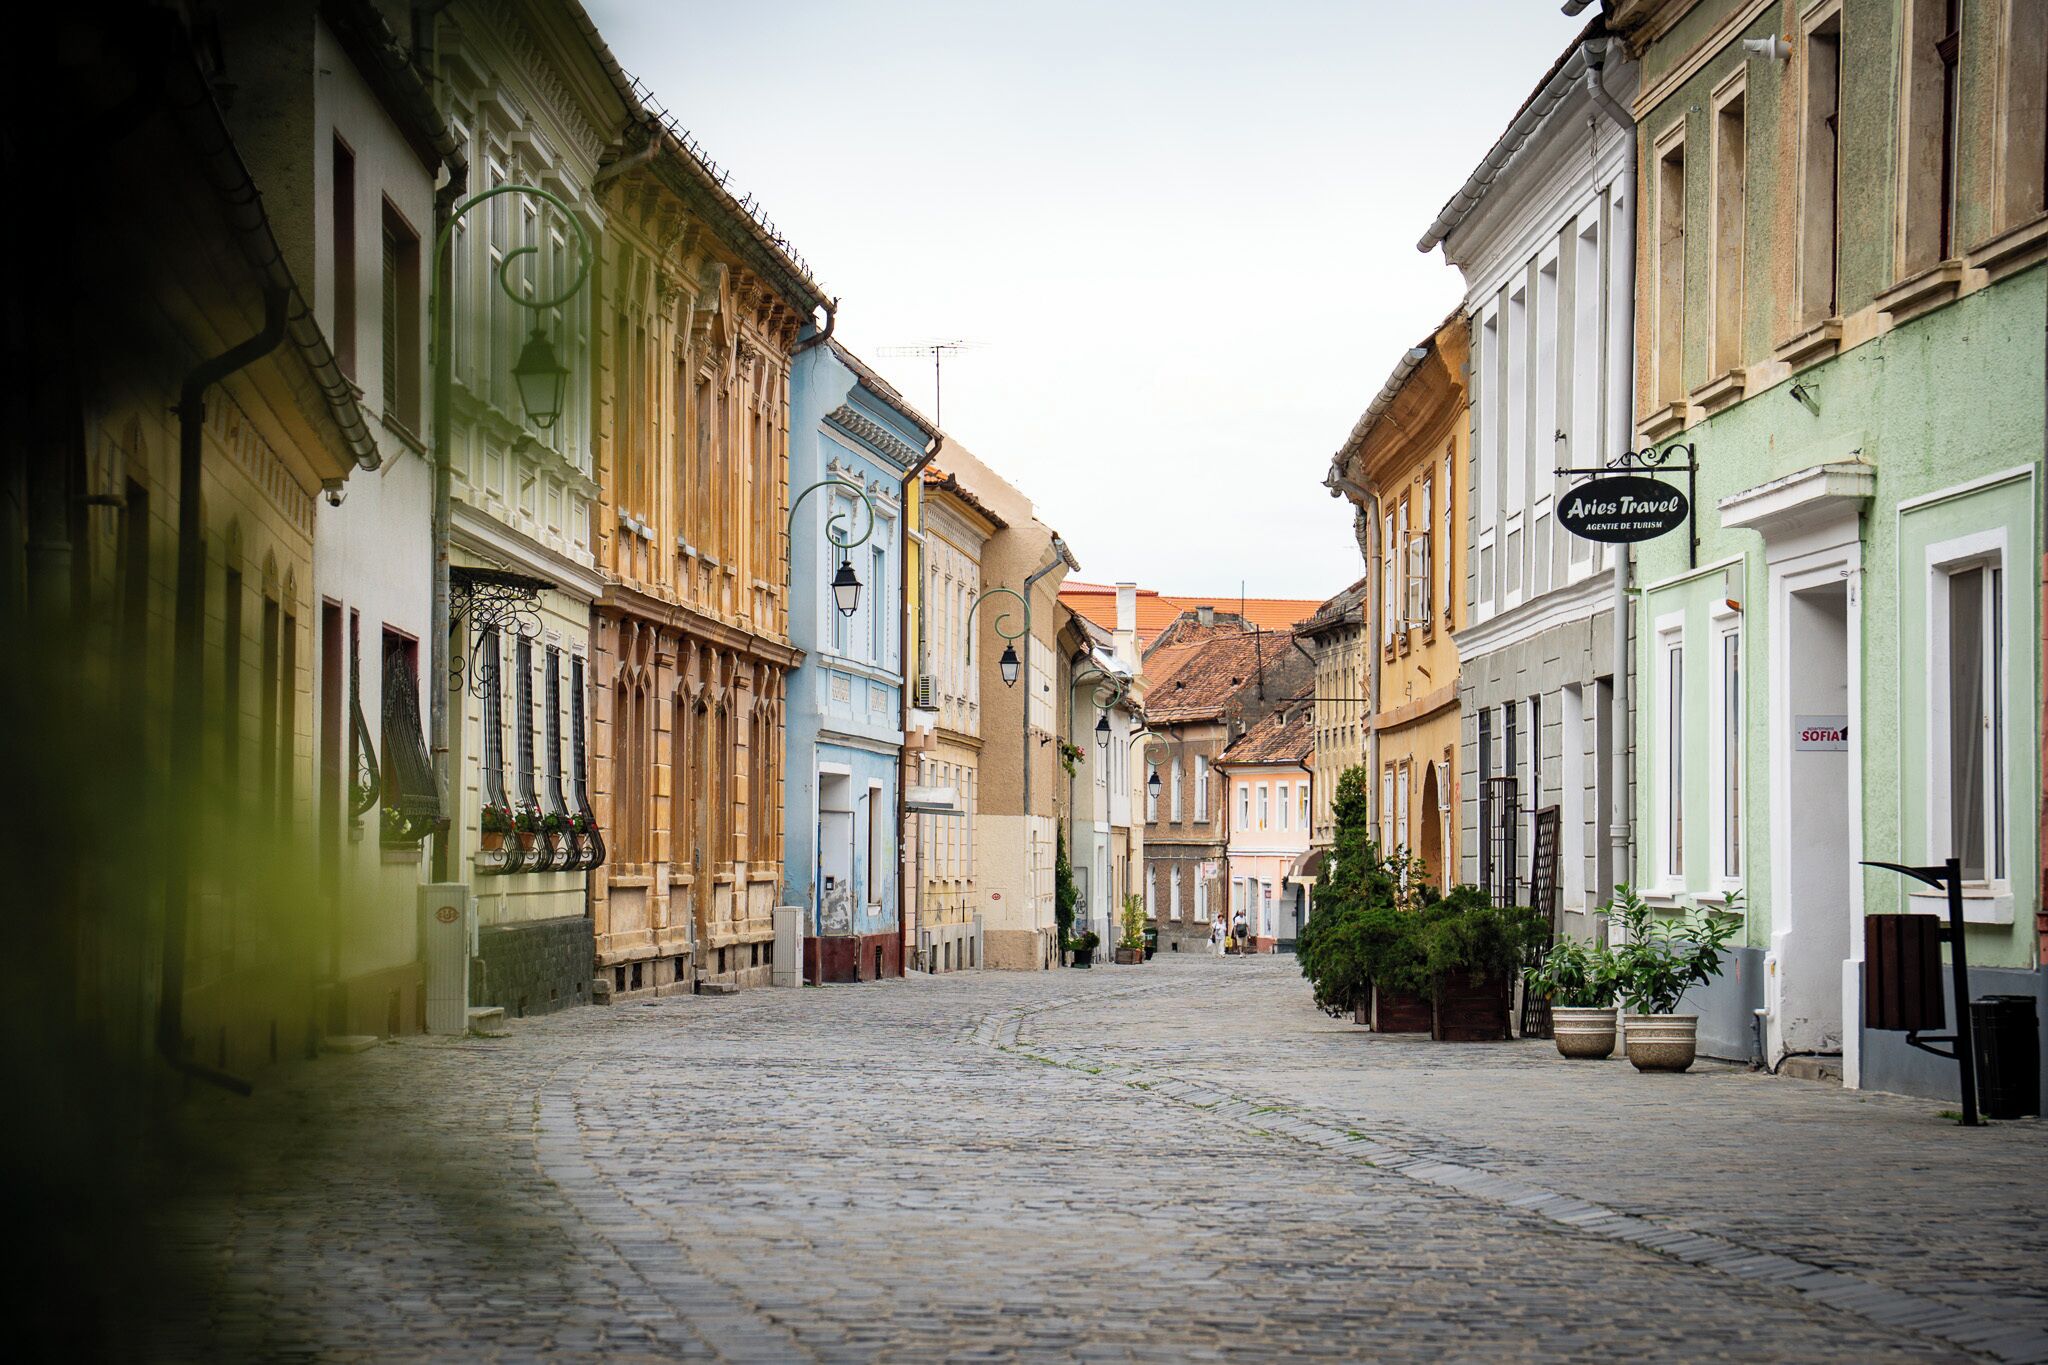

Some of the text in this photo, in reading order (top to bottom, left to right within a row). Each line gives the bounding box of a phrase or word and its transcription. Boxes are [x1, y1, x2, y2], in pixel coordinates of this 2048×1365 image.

[1567, 496, 1679, 519] Aries Travel
[1586, 521, 1663, 531] AGENTIE DE TURISM
[1802, 731, 1840, 742] SOFIA
